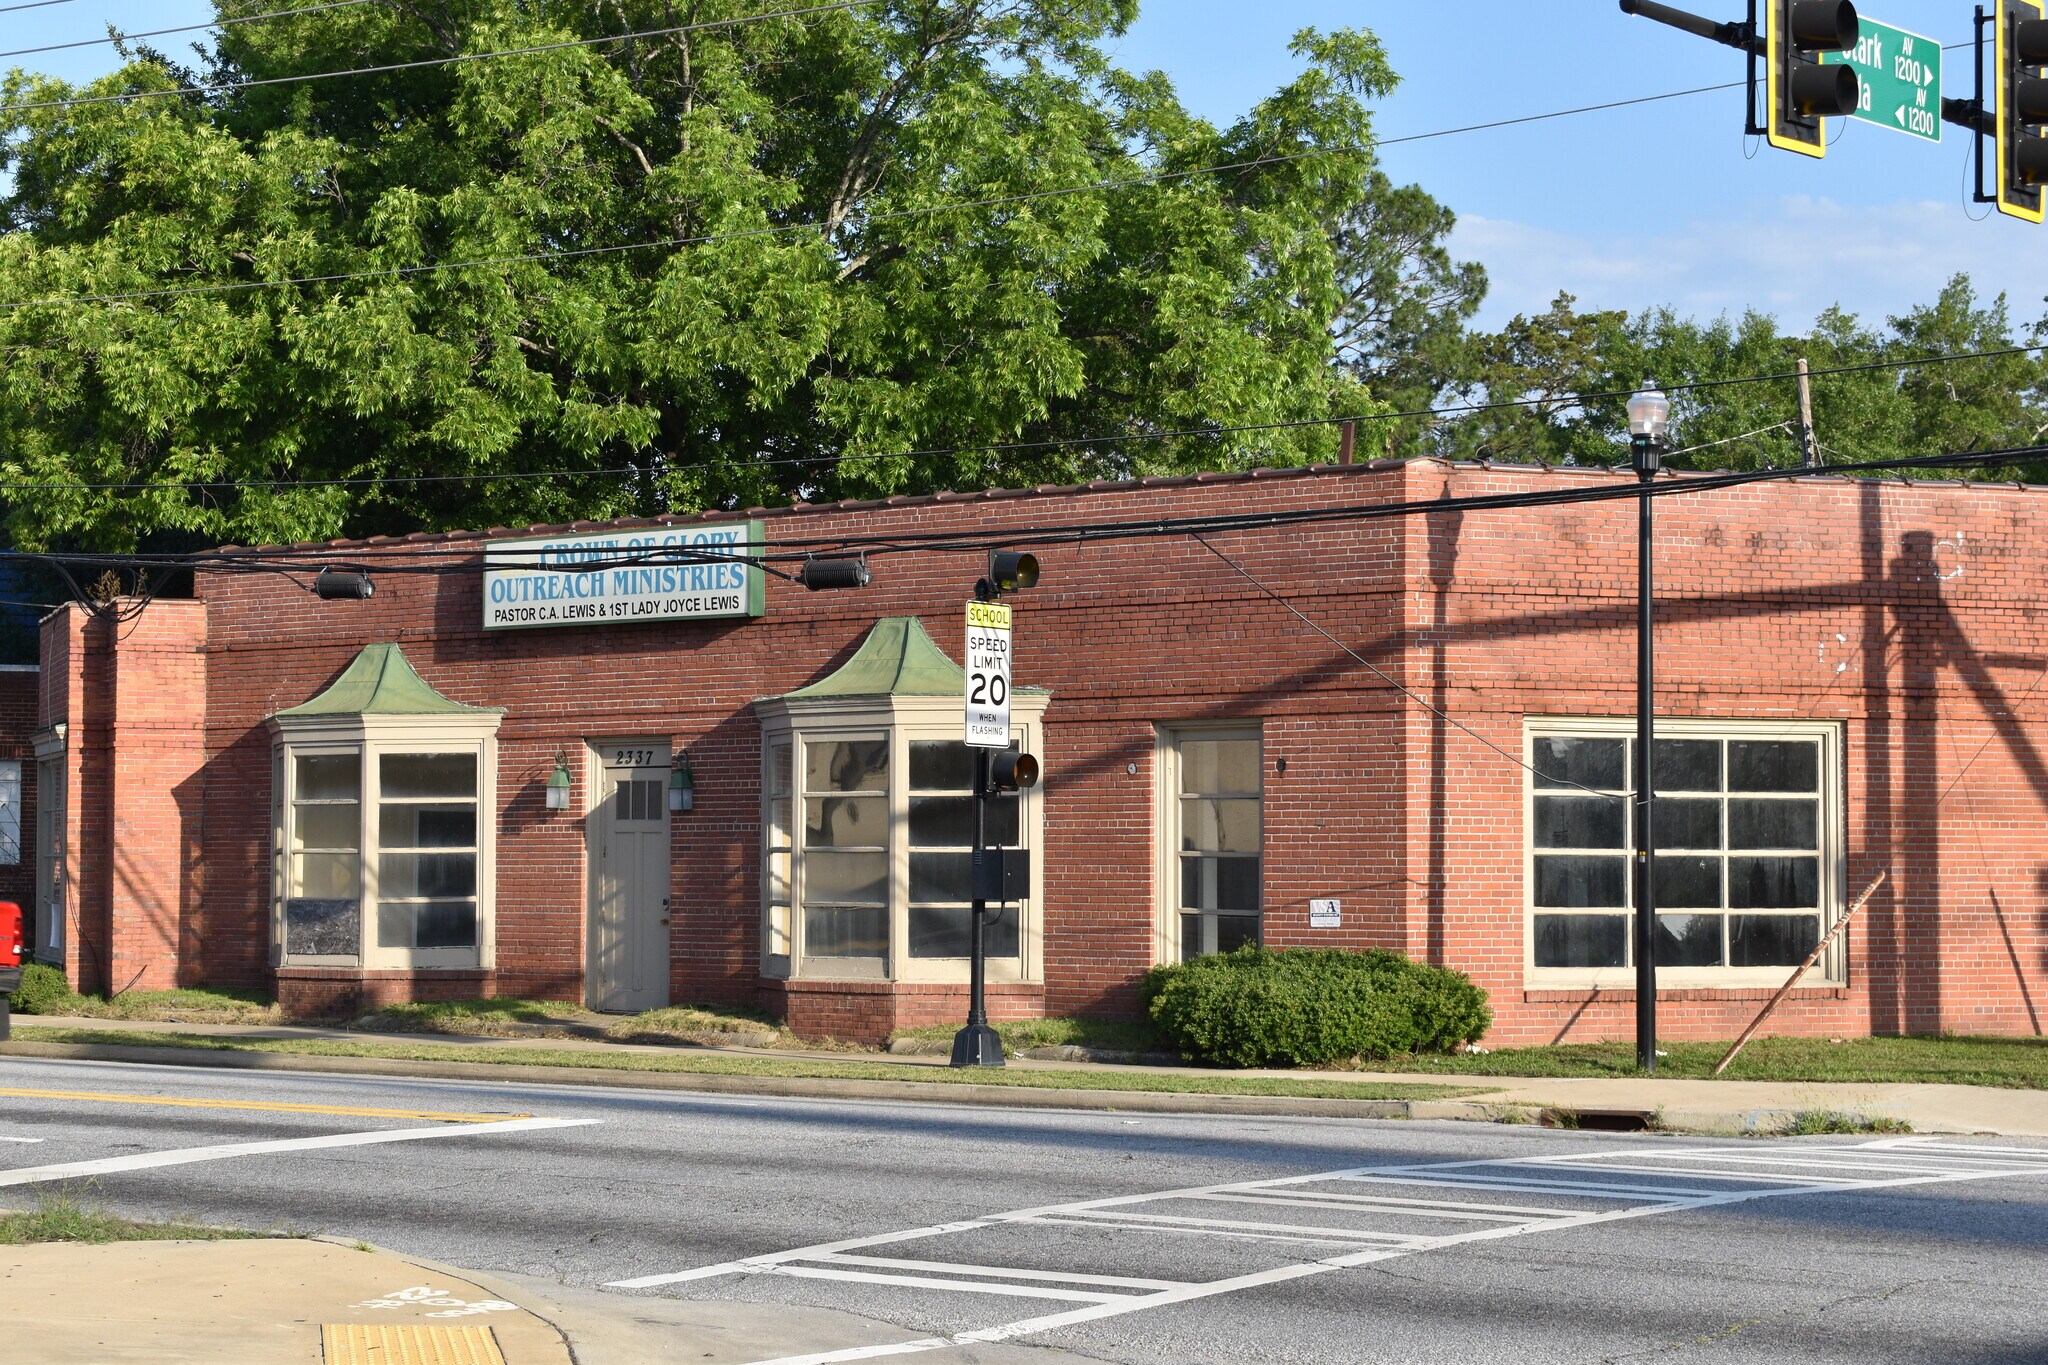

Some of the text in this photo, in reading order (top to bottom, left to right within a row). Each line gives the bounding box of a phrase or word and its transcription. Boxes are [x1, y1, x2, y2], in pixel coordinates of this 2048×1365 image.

[1902, 36, 1914, 56] AV
[1894, 55, 1920, 85] 1200
[1915, 87, 1927, 108] AV
[1908, 106, 1934, 136] 1200
[540, 539, 619, 565] CROWN
[626, 537, 656, 562] OF
[491, 563, 744, 603] OUTREACH MINISTRIES
[494, 595, 739, 622] PASTOR C.A. LEWIS & 1ST LADY JOYCE LEWIS
[969, 607, 1009, 625] SCHOOL
[970, 636, 1007, 653] SPEED
[973, 655, 1002, 670] LIMIT
[970, 673, 1006, 706] 20
[978, 712, 997, 723] WHEN
[971, 725, 1003, 736] FLASHING
[615, 750, 654, 765] 2337
